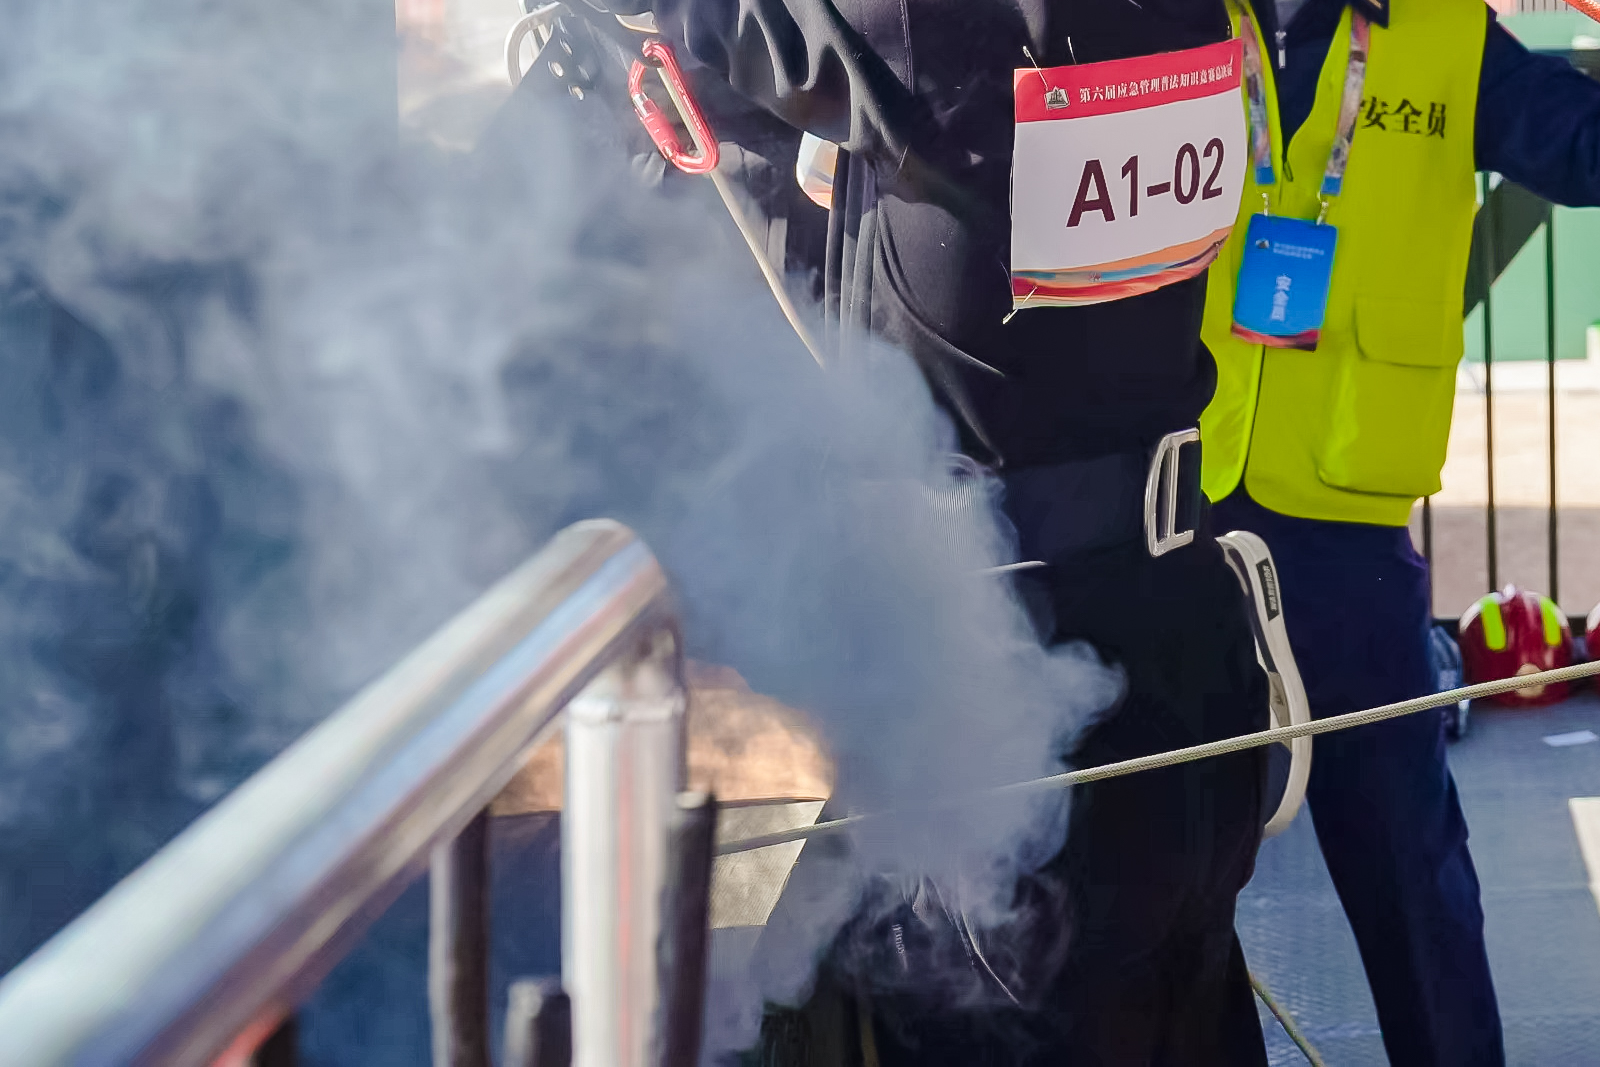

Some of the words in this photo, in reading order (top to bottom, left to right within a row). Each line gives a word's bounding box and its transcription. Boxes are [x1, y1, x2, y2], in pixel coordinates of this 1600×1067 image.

[1360, 96, 1447, 139] 安全员
[1066, 138, 1224, 227] A1-02
